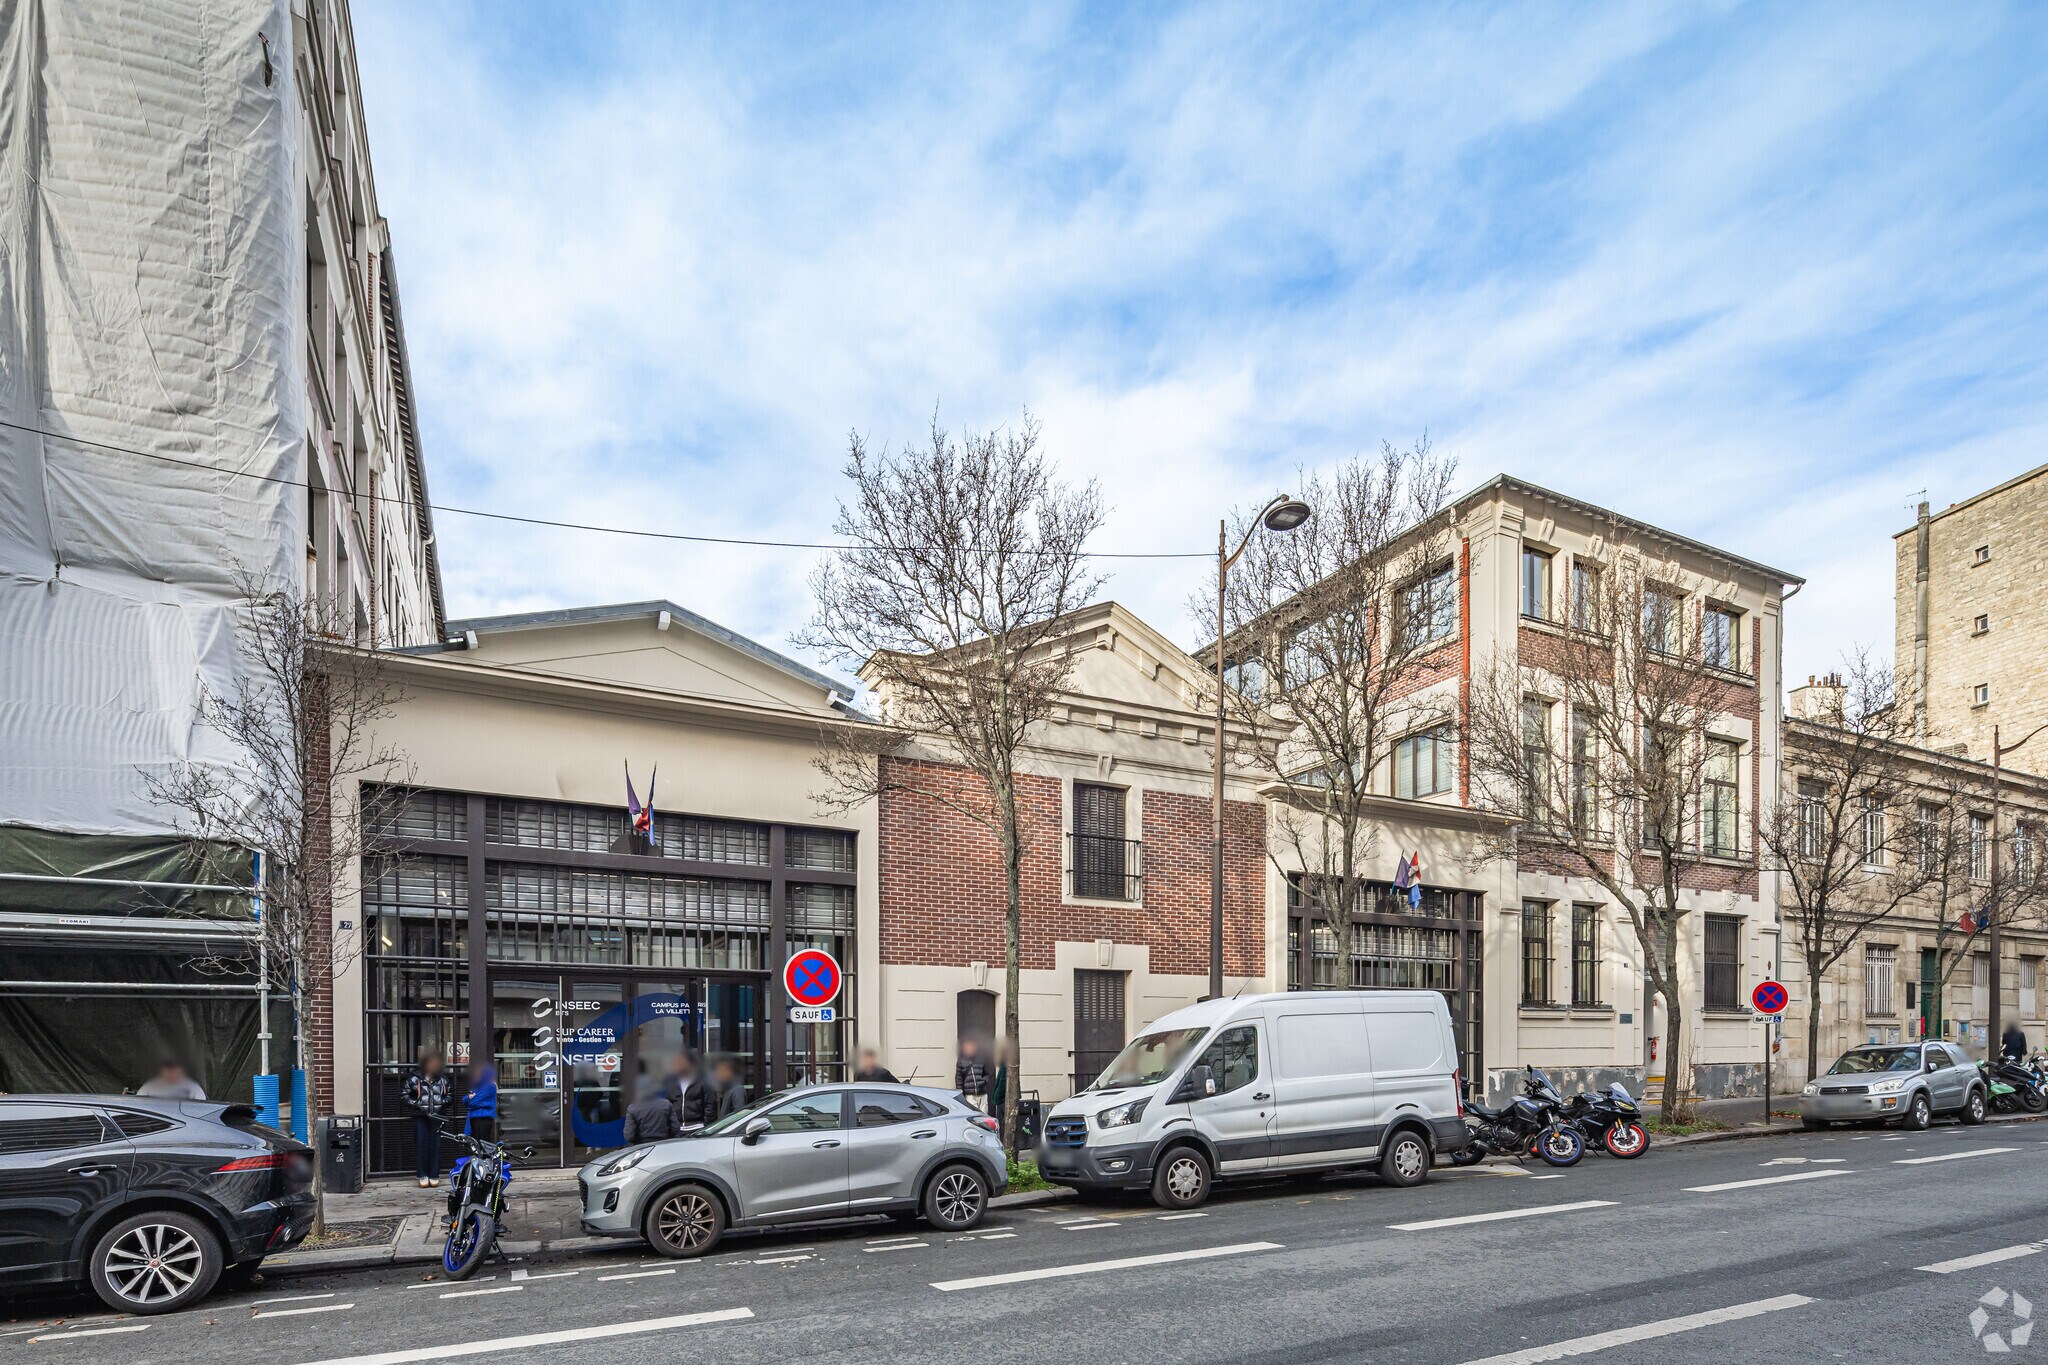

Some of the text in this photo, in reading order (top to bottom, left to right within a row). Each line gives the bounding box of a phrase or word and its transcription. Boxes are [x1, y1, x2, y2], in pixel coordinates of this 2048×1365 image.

[555, 1001, 601, 1010] INSEEC
[795, 1011, 820, 1019] SAUF
[555, 1028, 614, 1036] SUP CAREER
